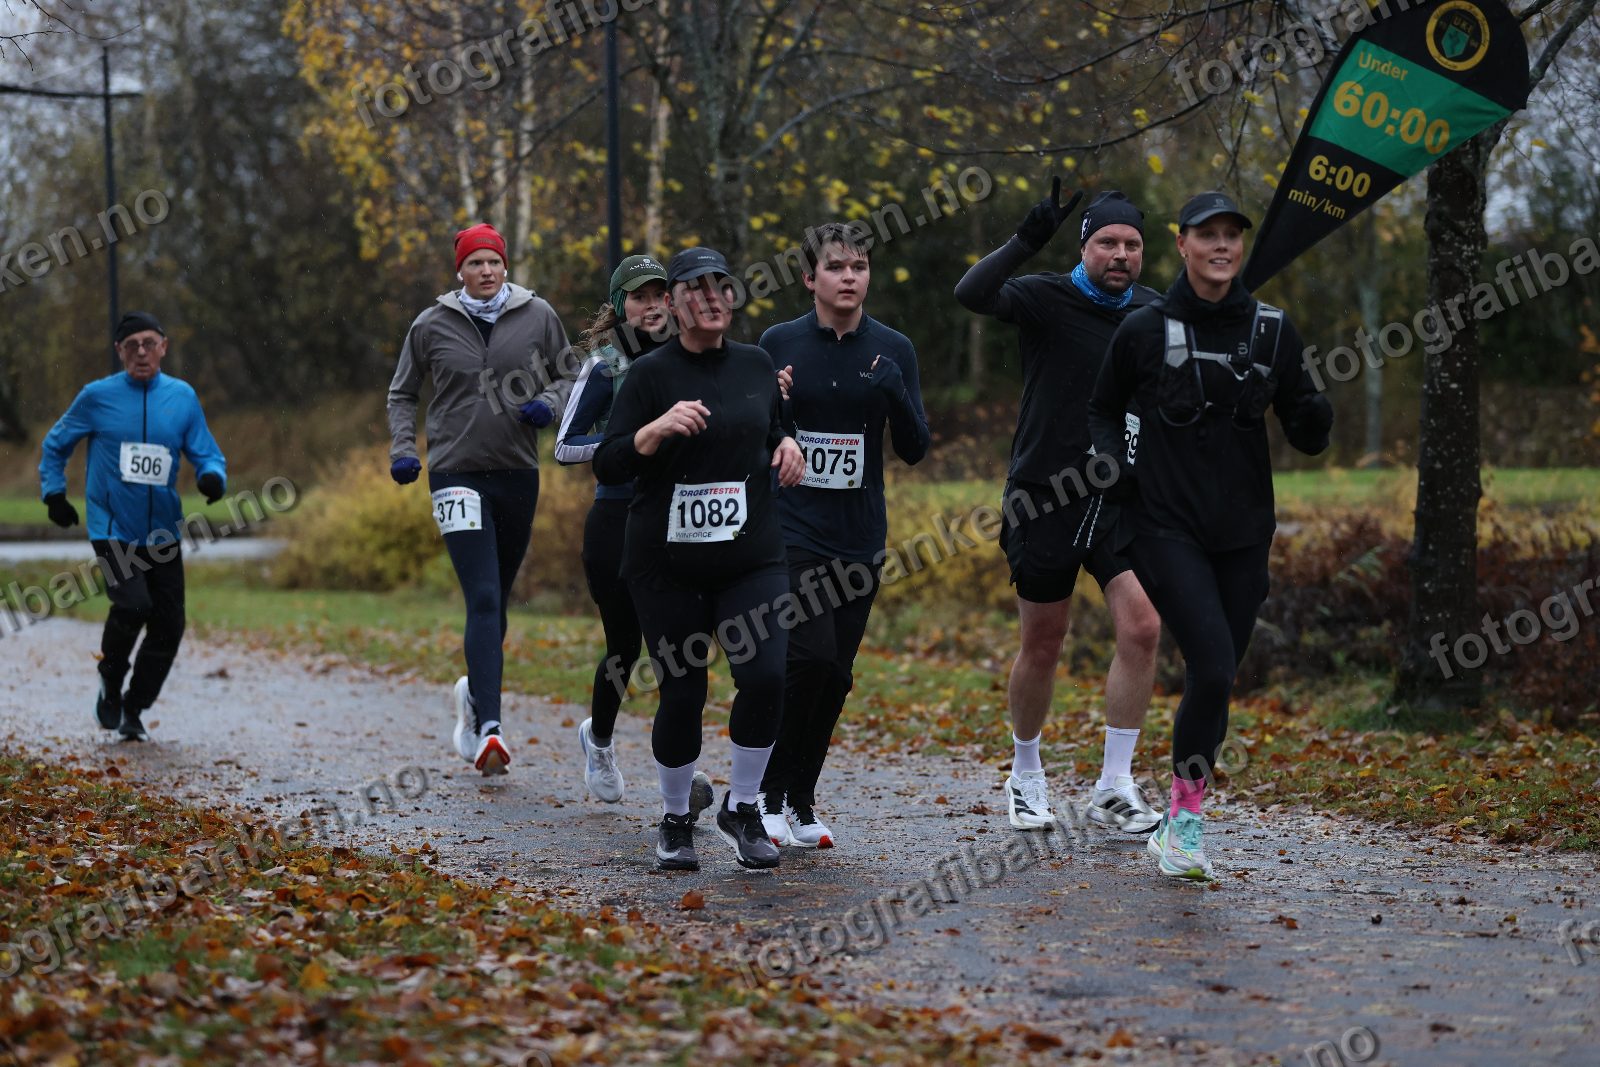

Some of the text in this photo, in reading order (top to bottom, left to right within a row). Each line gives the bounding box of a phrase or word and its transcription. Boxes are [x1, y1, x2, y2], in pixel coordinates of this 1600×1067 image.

[1358, 52, 1409, 81] Under
[1333, 80, 1450, 155] 60:00
[1308, 154, 1372, 198] 6:00
[1288, 188, 1347, 220] min/km
[799, 435, 860, 446] NORGESTESTEN
[131, 455, 162, 476] 506
[802, 446, 856, 476] 1075
[803, 476, 831, 484] NFORCE
[437, 498, 465, 523] 371
[677, 498, 740, 528] 1082
